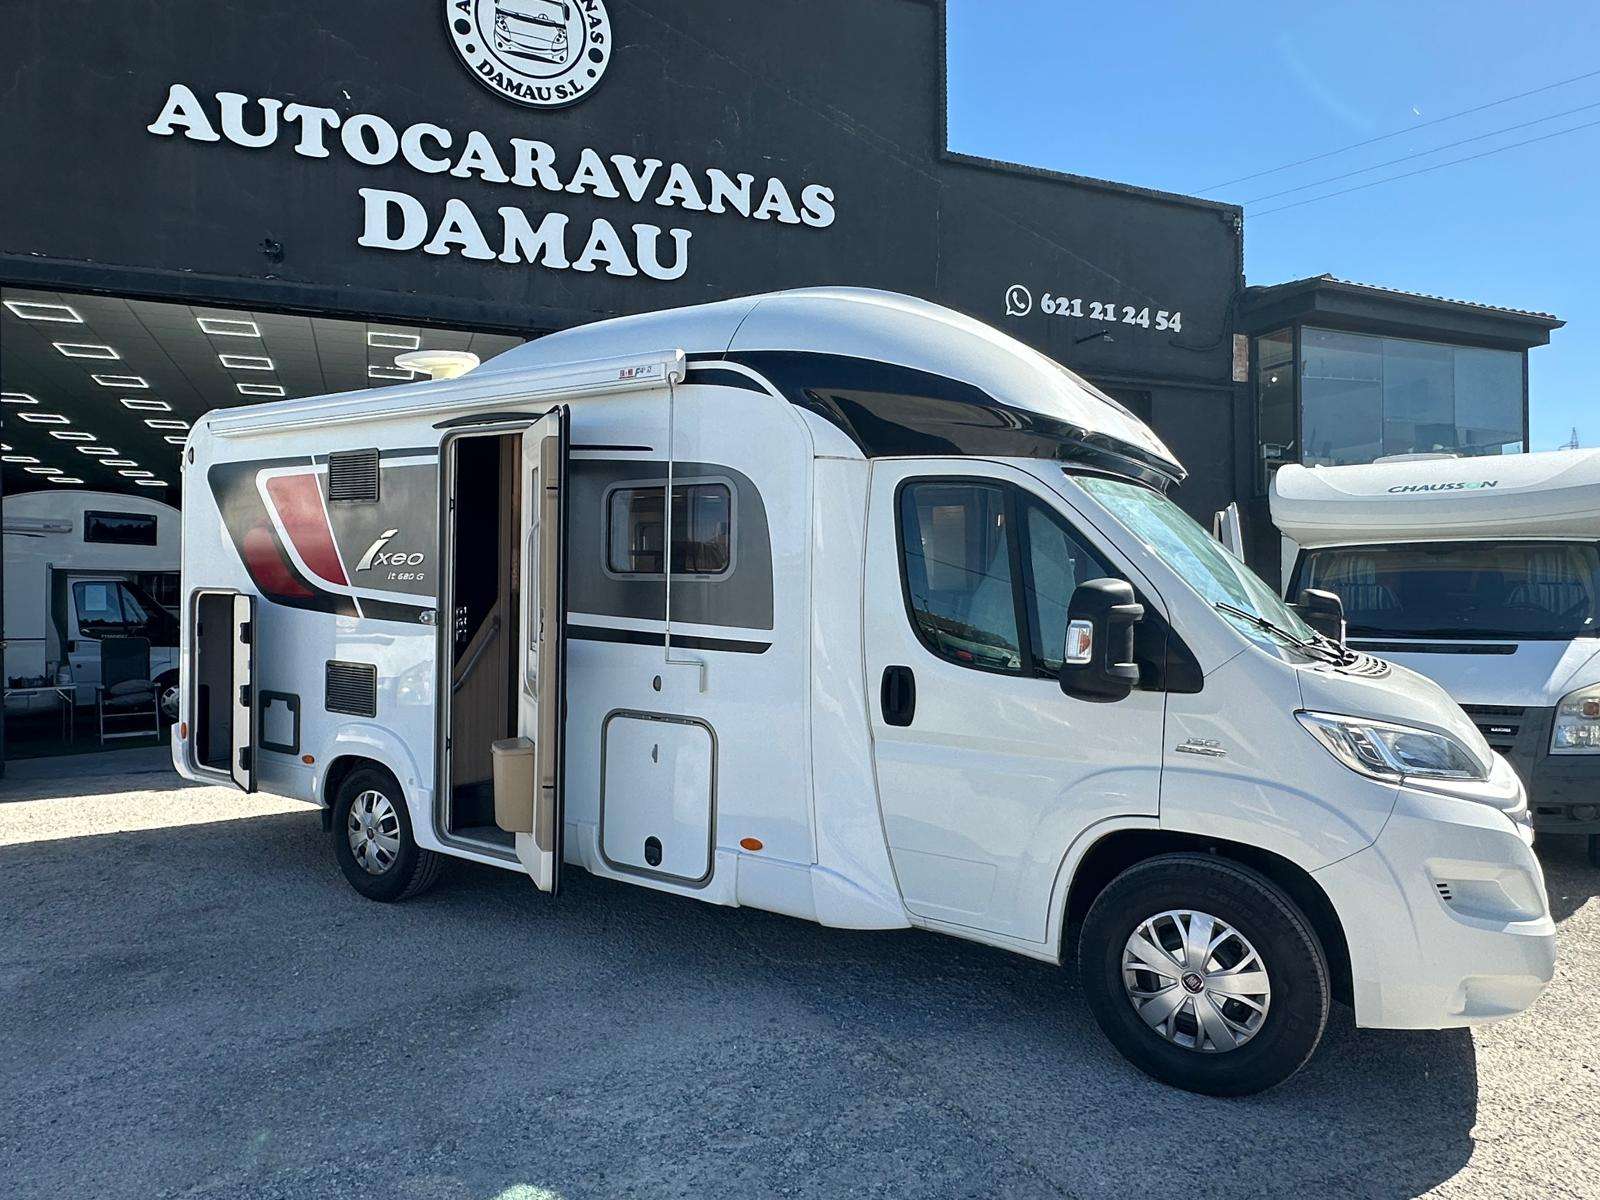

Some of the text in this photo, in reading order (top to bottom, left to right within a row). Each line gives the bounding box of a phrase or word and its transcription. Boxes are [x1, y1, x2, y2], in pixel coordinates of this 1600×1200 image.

[476, 59, 552, 101] DAMAU
[146, 83, 836, 228] AUTOCARAVANAS
[357, 187, 693, 281] DAMAU
[1040, 292, 1182, 333] 621 21 24 54
[1387, 480, 1499, 494] CHAUSSON
[397, 572, 415, 580] 680
[416, 572, 425, 580] G
